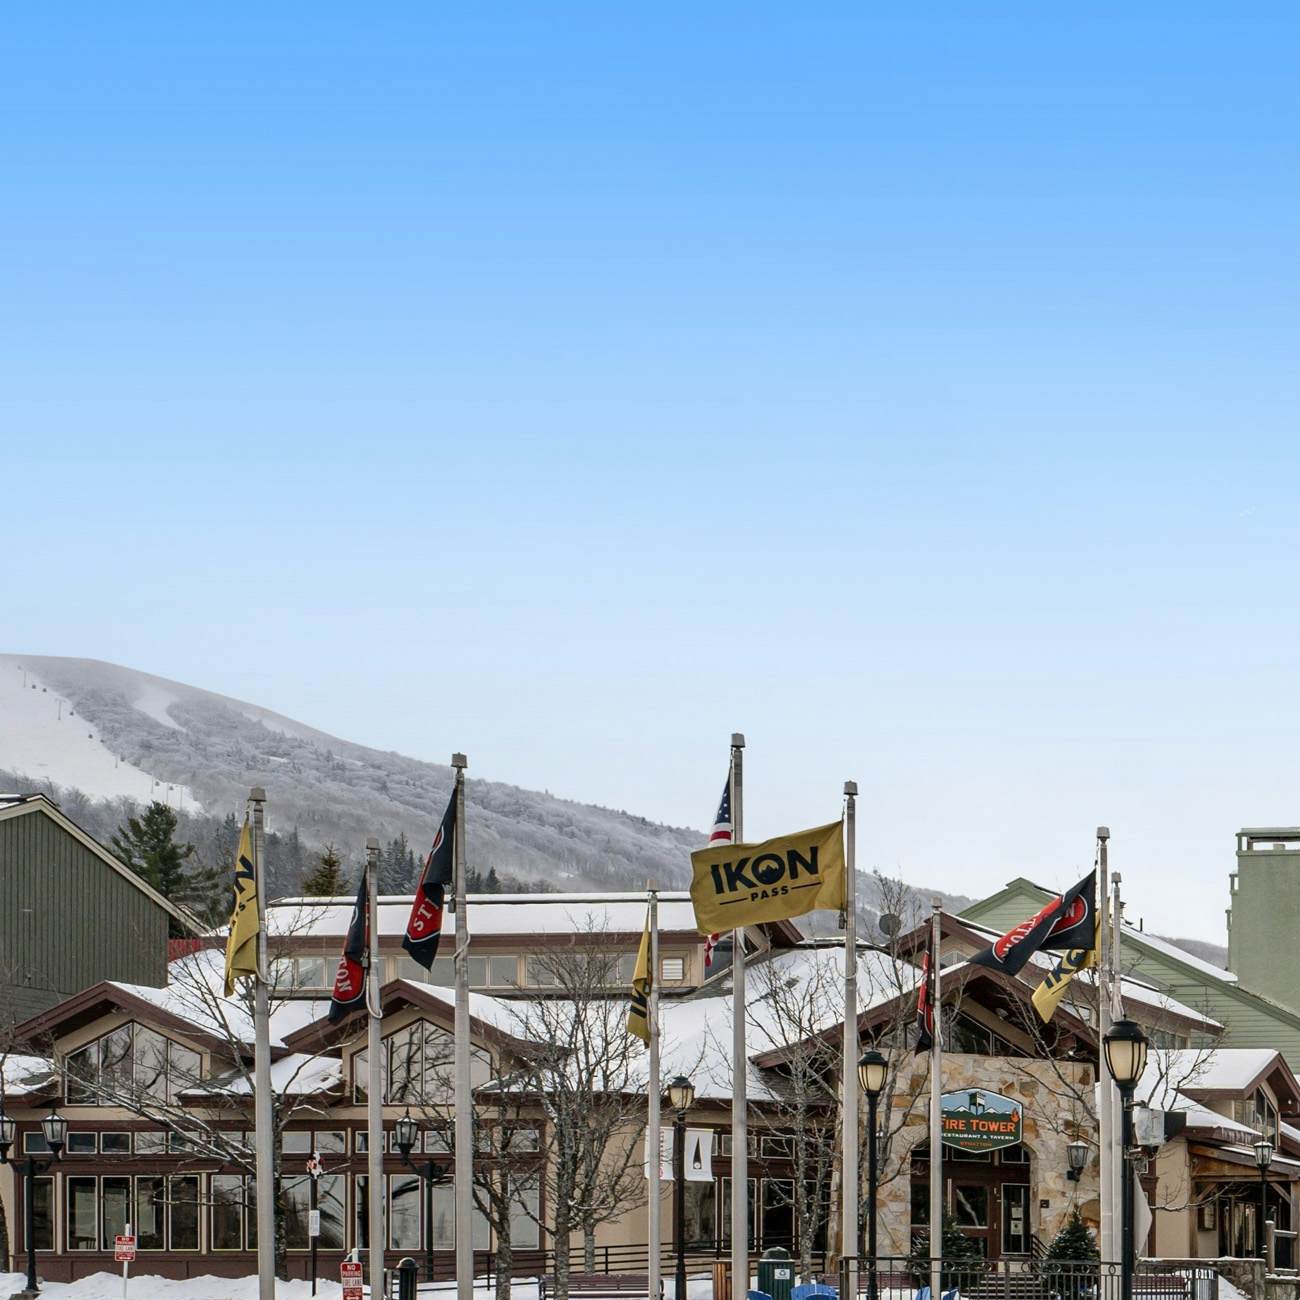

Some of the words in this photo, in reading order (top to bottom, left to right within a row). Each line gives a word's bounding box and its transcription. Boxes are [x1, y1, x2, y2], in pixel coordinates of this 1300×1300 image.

[711, 846, 819, 894] IKON
[751, 886, 789, 902] PASS
[1044, 949, 1087, 988] IKO
[970, 1119, 1016, 1133] TOWER
